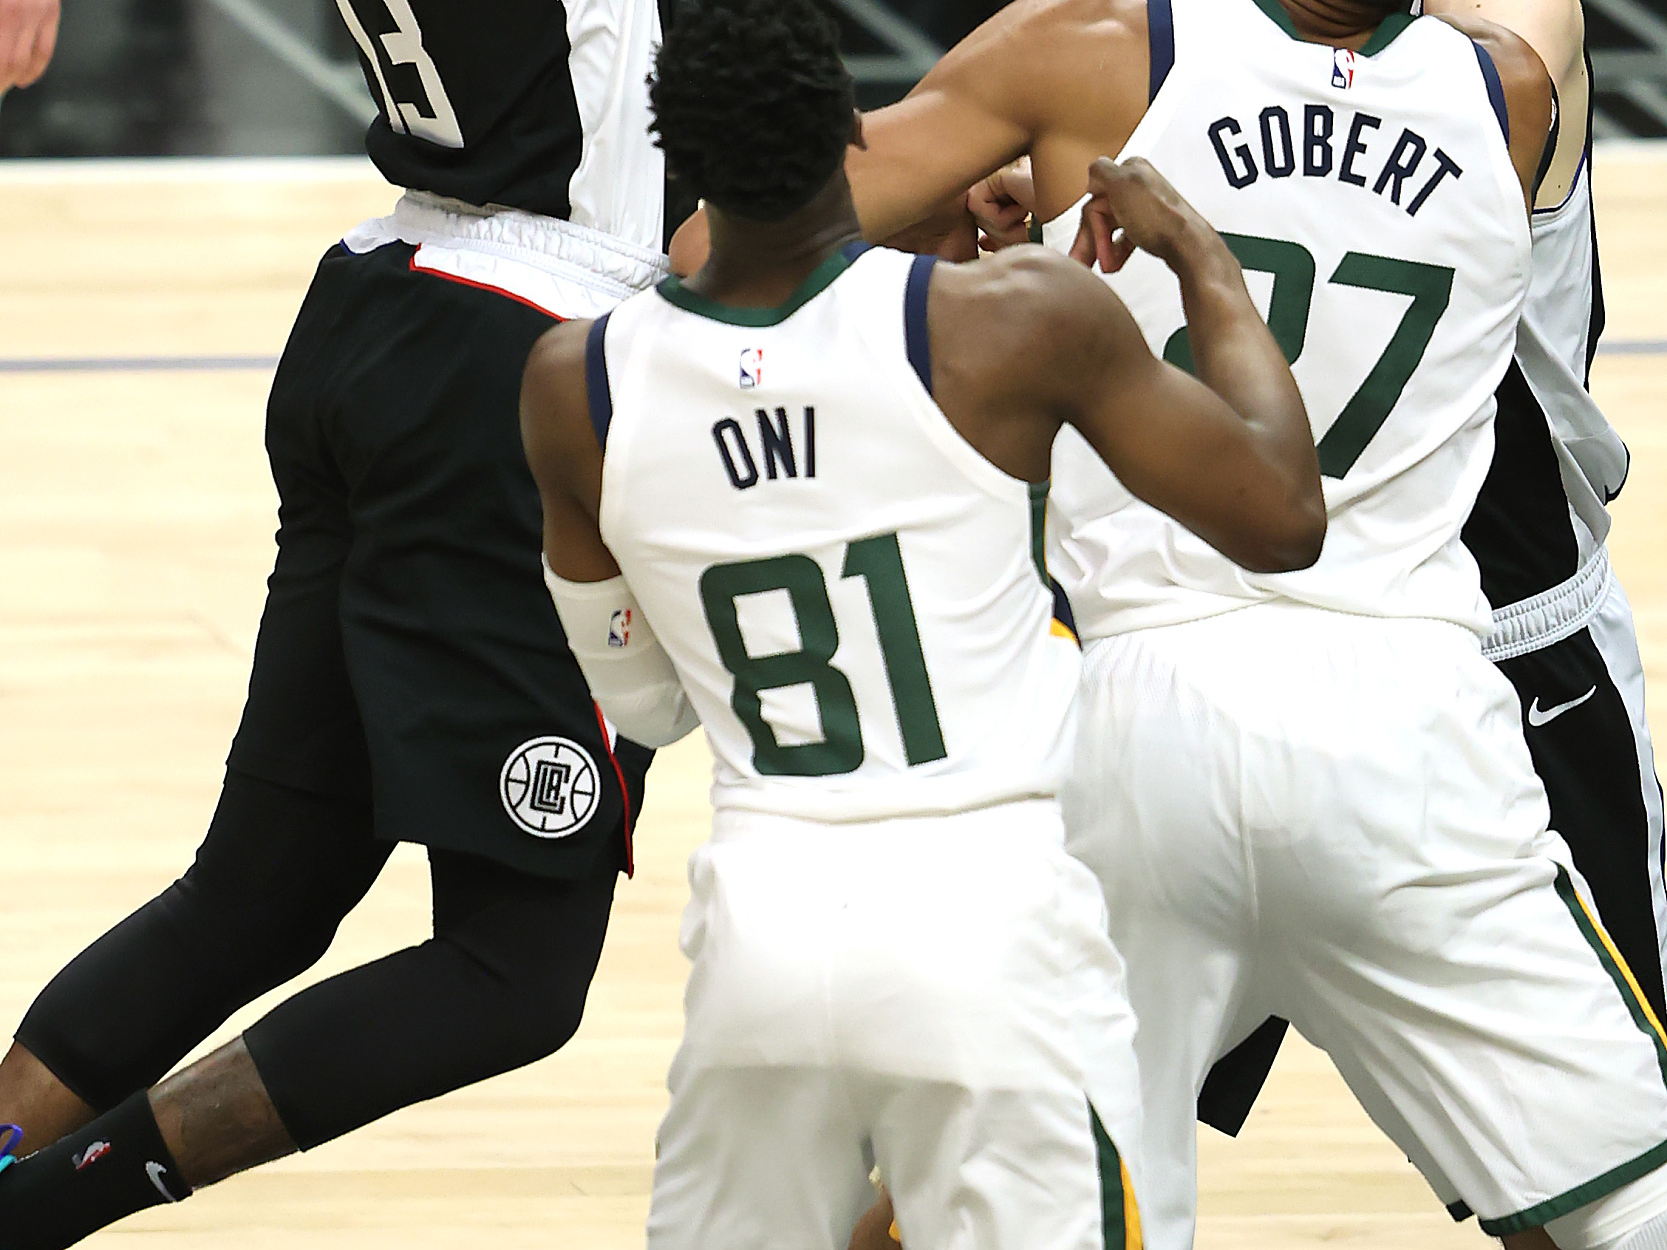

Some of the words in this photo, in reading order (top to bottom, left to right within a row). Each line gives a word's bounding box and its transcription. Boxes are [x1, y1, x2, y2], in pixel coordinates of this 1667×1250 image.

[1208, 103, 1464, 218] GOBERT
[711, 405, 816, 491] ONI
[699, 531, 948, 777] 81
